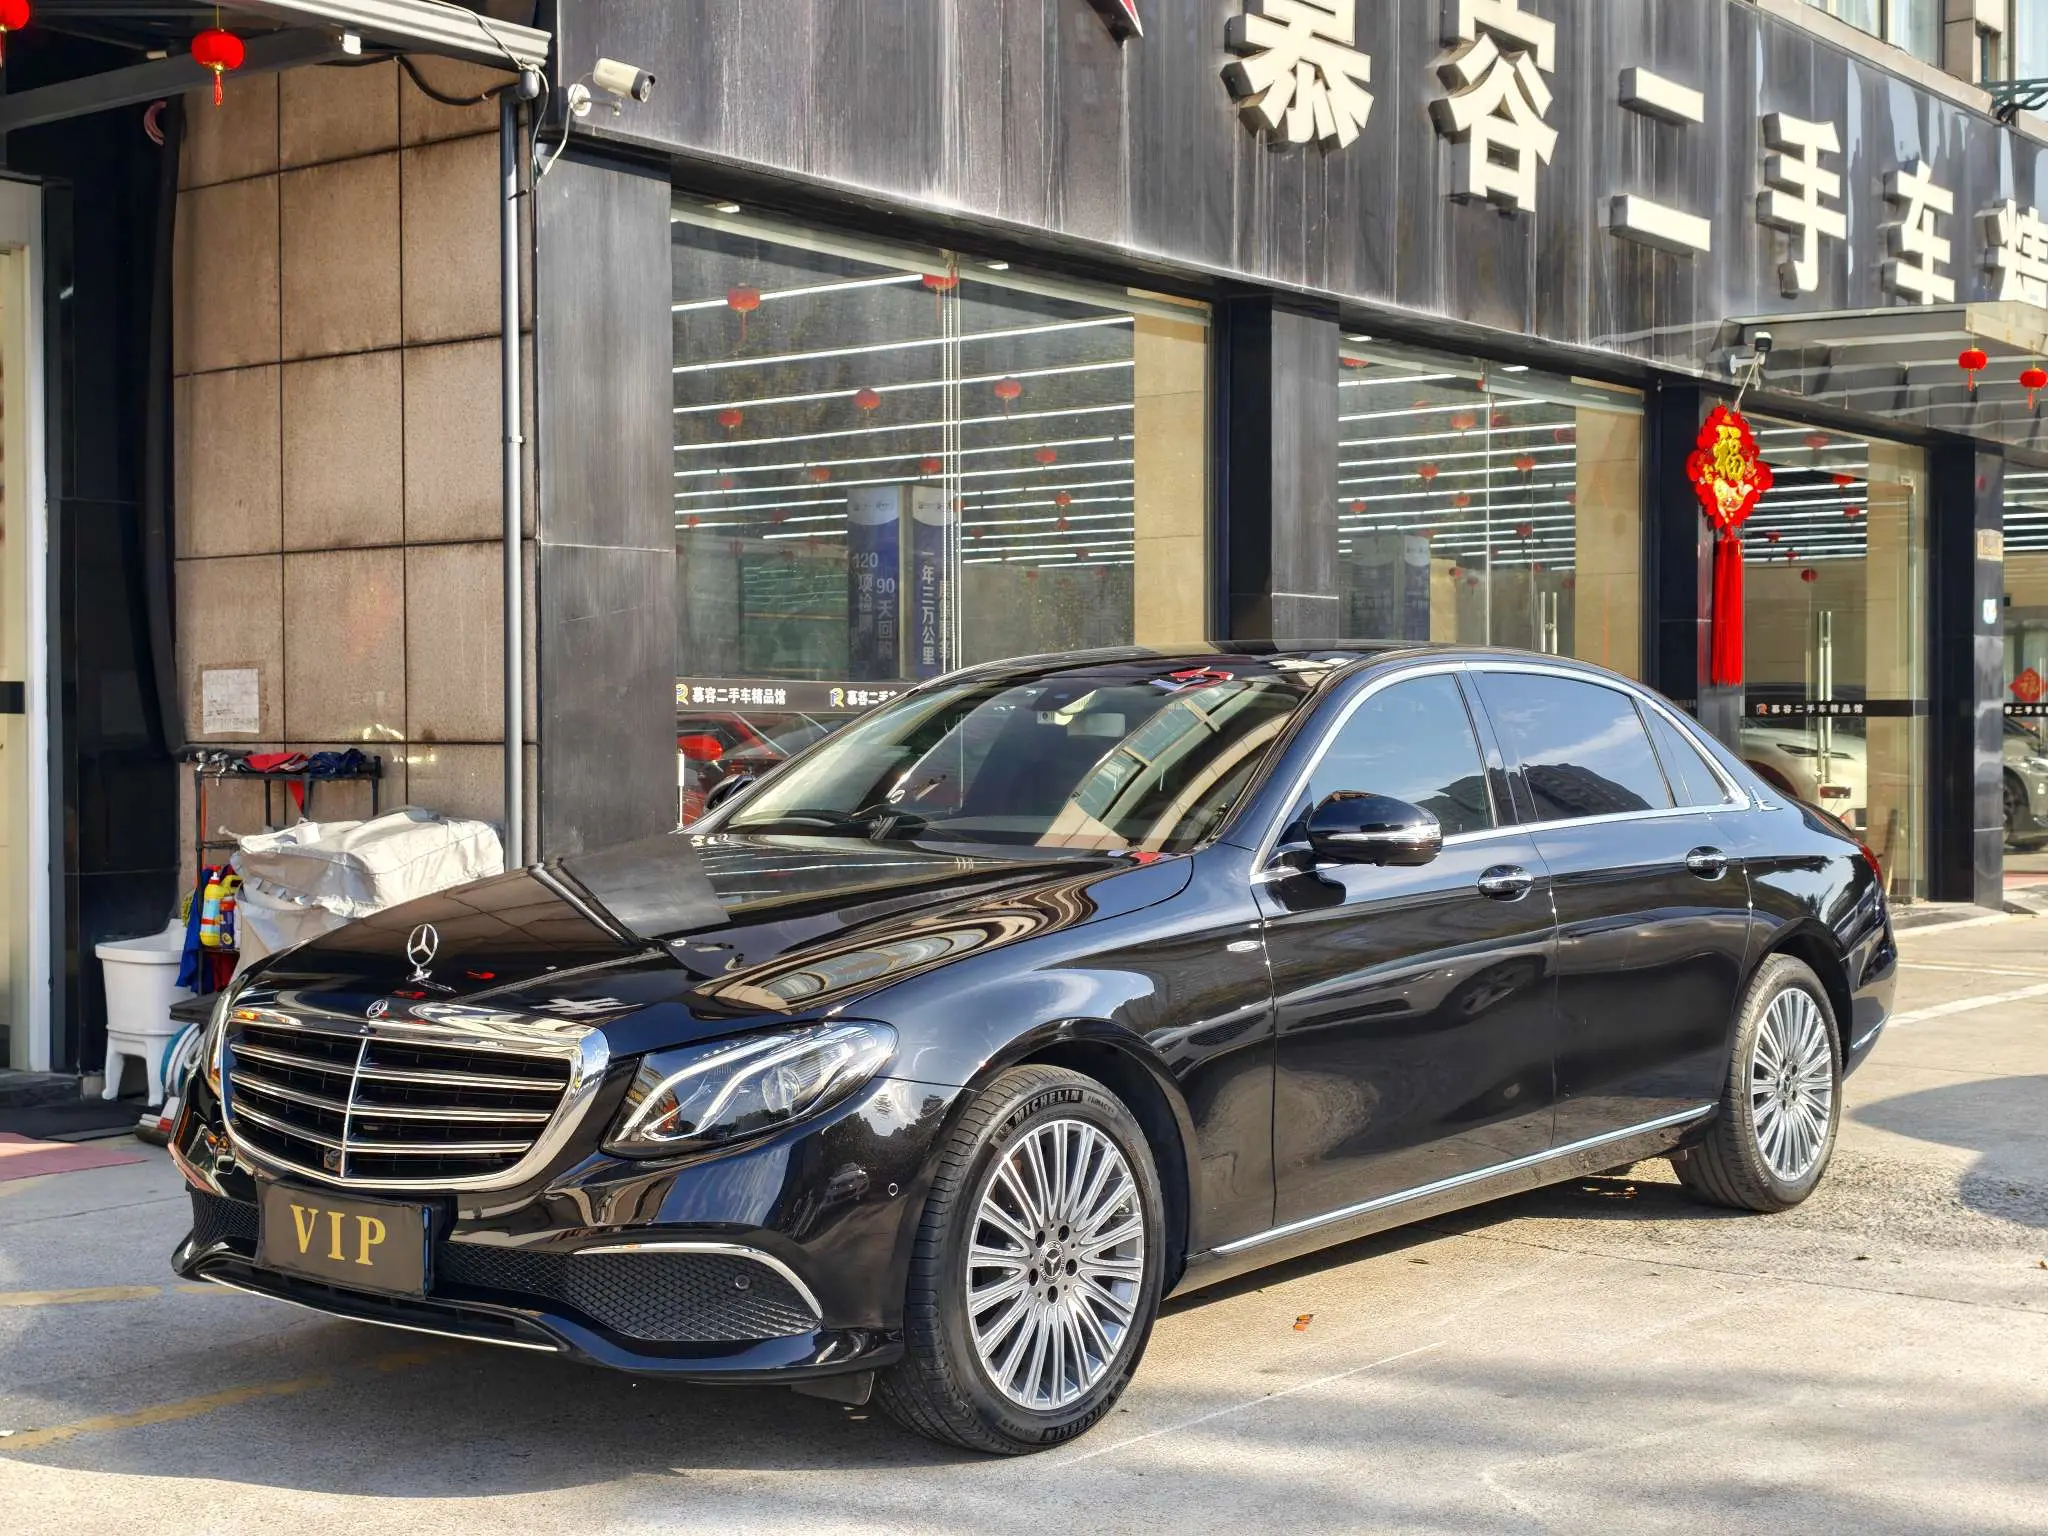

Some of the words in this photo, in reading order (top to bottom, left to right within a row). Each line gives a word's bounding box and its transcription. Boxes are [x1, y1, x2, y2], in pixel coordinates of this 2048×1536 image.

[1713, 425, 1746, 481] 福
[921, 551, 936, 665] 一年三万公里
[692, 686, 786, 705] 慕容二手车精品馆
[1771, 704, 1864, 714] 慕容二手车精品馆
[2004, 705, 2048, 715] 容二手车
[1014, 1090, 1081, 1121] MICHELIN
[289, 1204, 386, 1266] VIP
